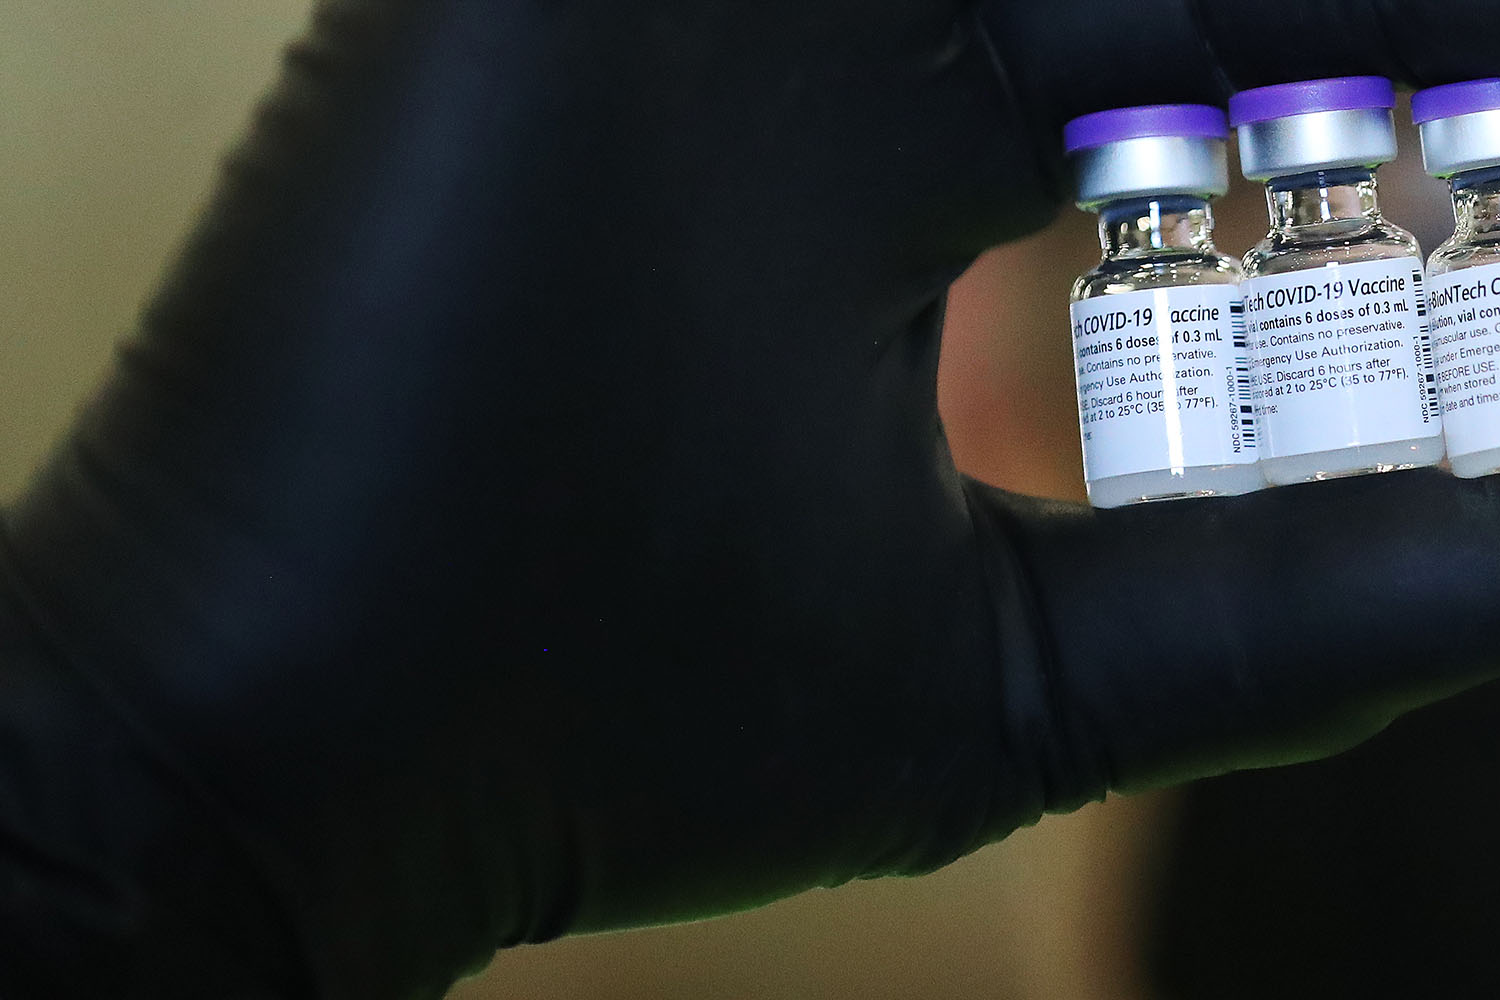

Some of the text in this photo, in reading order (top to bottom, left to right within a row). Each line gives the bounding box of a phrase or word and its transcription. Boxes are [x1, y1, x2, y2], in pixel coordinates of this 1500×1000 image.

[1266, 281, 1344, 309] COVID-19
[1348, 275, 1405, 297] Vaccine
[1084, 308, 1153, 335] COVID-19
[1168, 304, 1219, 323] accine
[1259, 314, 1302, 331] contains
[1305, 311, 1313, 324] 6
[1316, 306, 1355, 323] doses
[1358, 303, 1371, 318] of
[1373, 301, 1391, 315] 0.3
[1393, 298, 1409, 313] mL
[1457, 307, 1476, 323] vial
[1115, 337, 1123, 350] 6
[1172, 330, 1179, 343] f
[1183, 329, 1201, 343] 0.3
[1204, 328, 1223, 342] mL
[1270, 331, 1315, 347] Contains
[1317, 328, 1333, 340] no
[1336, 320, 1406, 340] preservative.
[1469, 327, 1492, 338] use.
[1086, 358, 1124, 373] Contains
[1127, 356, 1141, 366] no
[1144, 348, 1217, 366] preervative.
[1295, 346, 1318, 362] Use
[1321, 337, 1404, 358] Authorization.
[1106, 376, 1126, 387] Use
[1130, 366, 1214, 384] Authozation.
[1275, 386, 1284, 396] at
[1286, 383, 1292, 394] 2
[1295, 383, 1306, 393] to
[1309, 375, 1337, 392] 25°C
[1363, 372, 1375, 383] to
[1379, 367, 1409, 382] 77°F).
[1276, 367, 1315, 383] Discard
[1318, 365, 1326, 376] 6
[1328, 360, 1363, 375] hours
[1366, 356, 1391, 370] after
[1441, 365, 1471, 382] BEFORE
[1472, 360, 1500, 375] USE.
[1463, 374, 1496, 390] stored
[1091, 392, 1123, 409] Discard
[1126, 391, 1133, 402] 6
[1136, 390, 1163, 401] hour
[1176, 385, 1198, 397] fter
[1459, 395, 1475, 408] and
[1090, 412, 1097, 422] at
[1098, 409, 1103, 421] 2
[1105, 409, 1115, 419] to
[1117, 402, 1144, 417] 25°C
[1225, 366, 1241, 453] NDC 59267-1000-1
[1420, 402, 1430, 424] NDC
